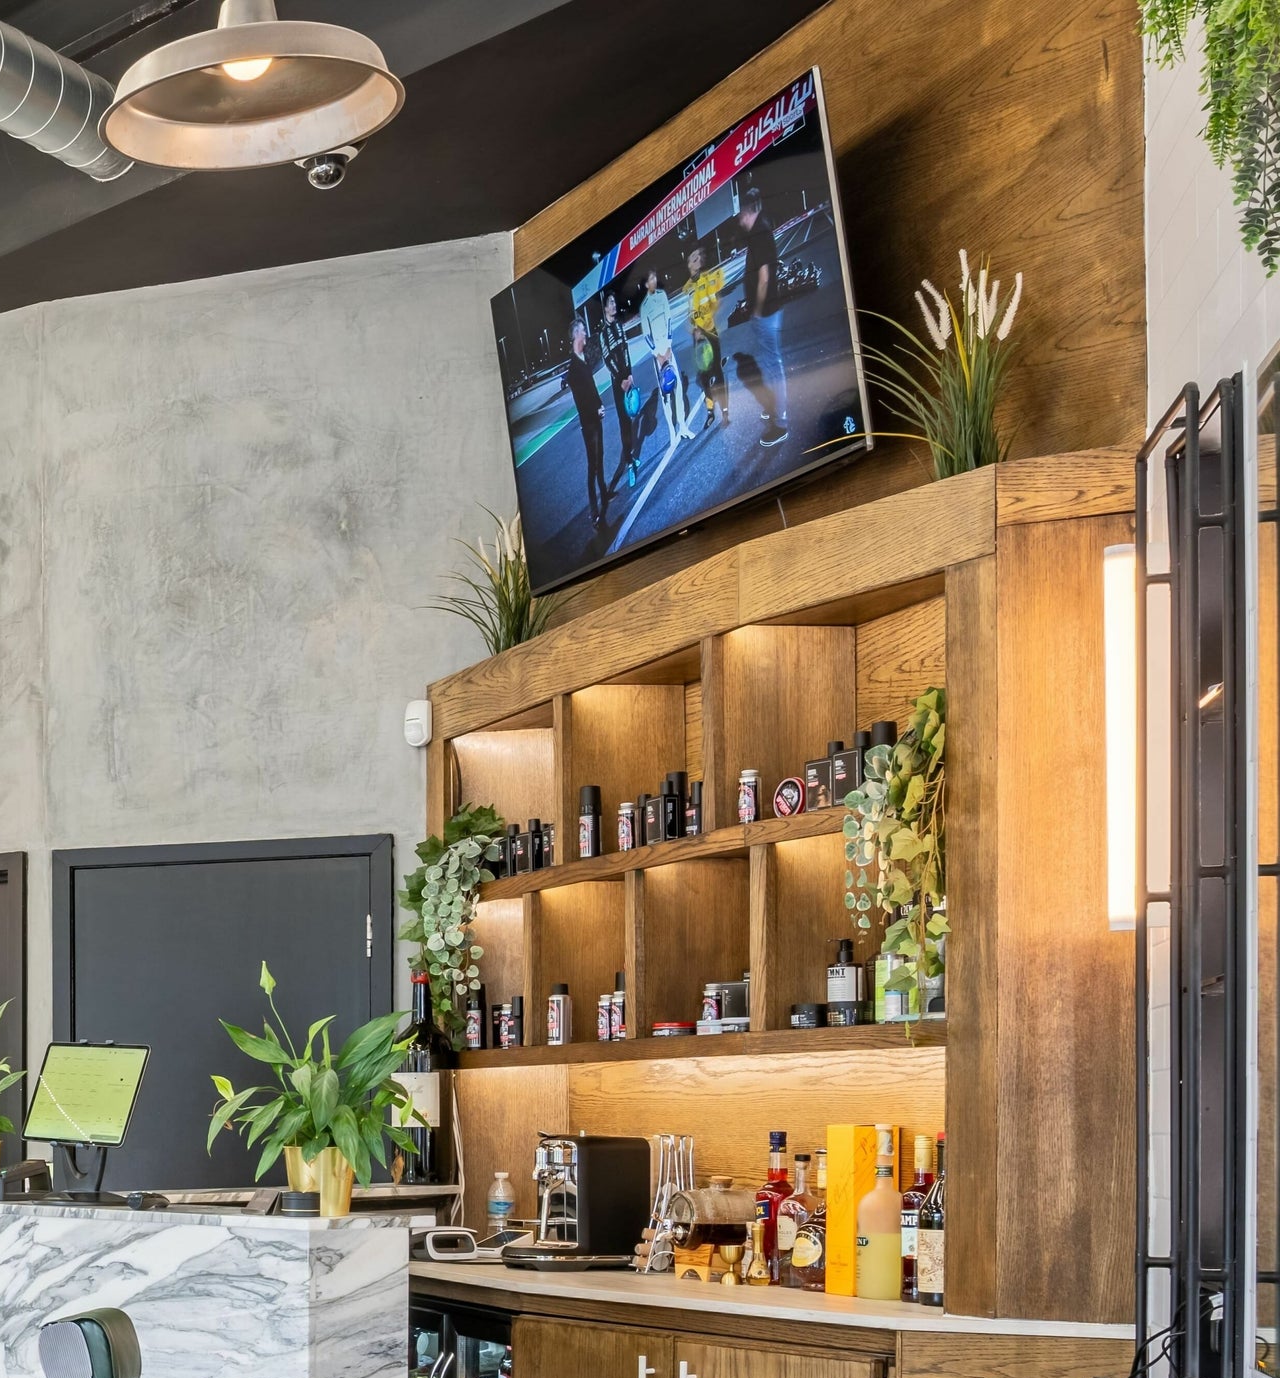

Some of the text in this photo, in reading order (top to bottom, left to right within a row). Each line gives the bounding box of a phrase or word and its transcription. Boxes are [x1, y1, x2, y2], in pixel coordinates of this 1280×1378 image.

[630, 159, 716, 251] BAHRAIN INTERNATIONAL
[653, 181, 711, 241] KARTING CIRCUIT
[827, 968, 846, 976] MNT
